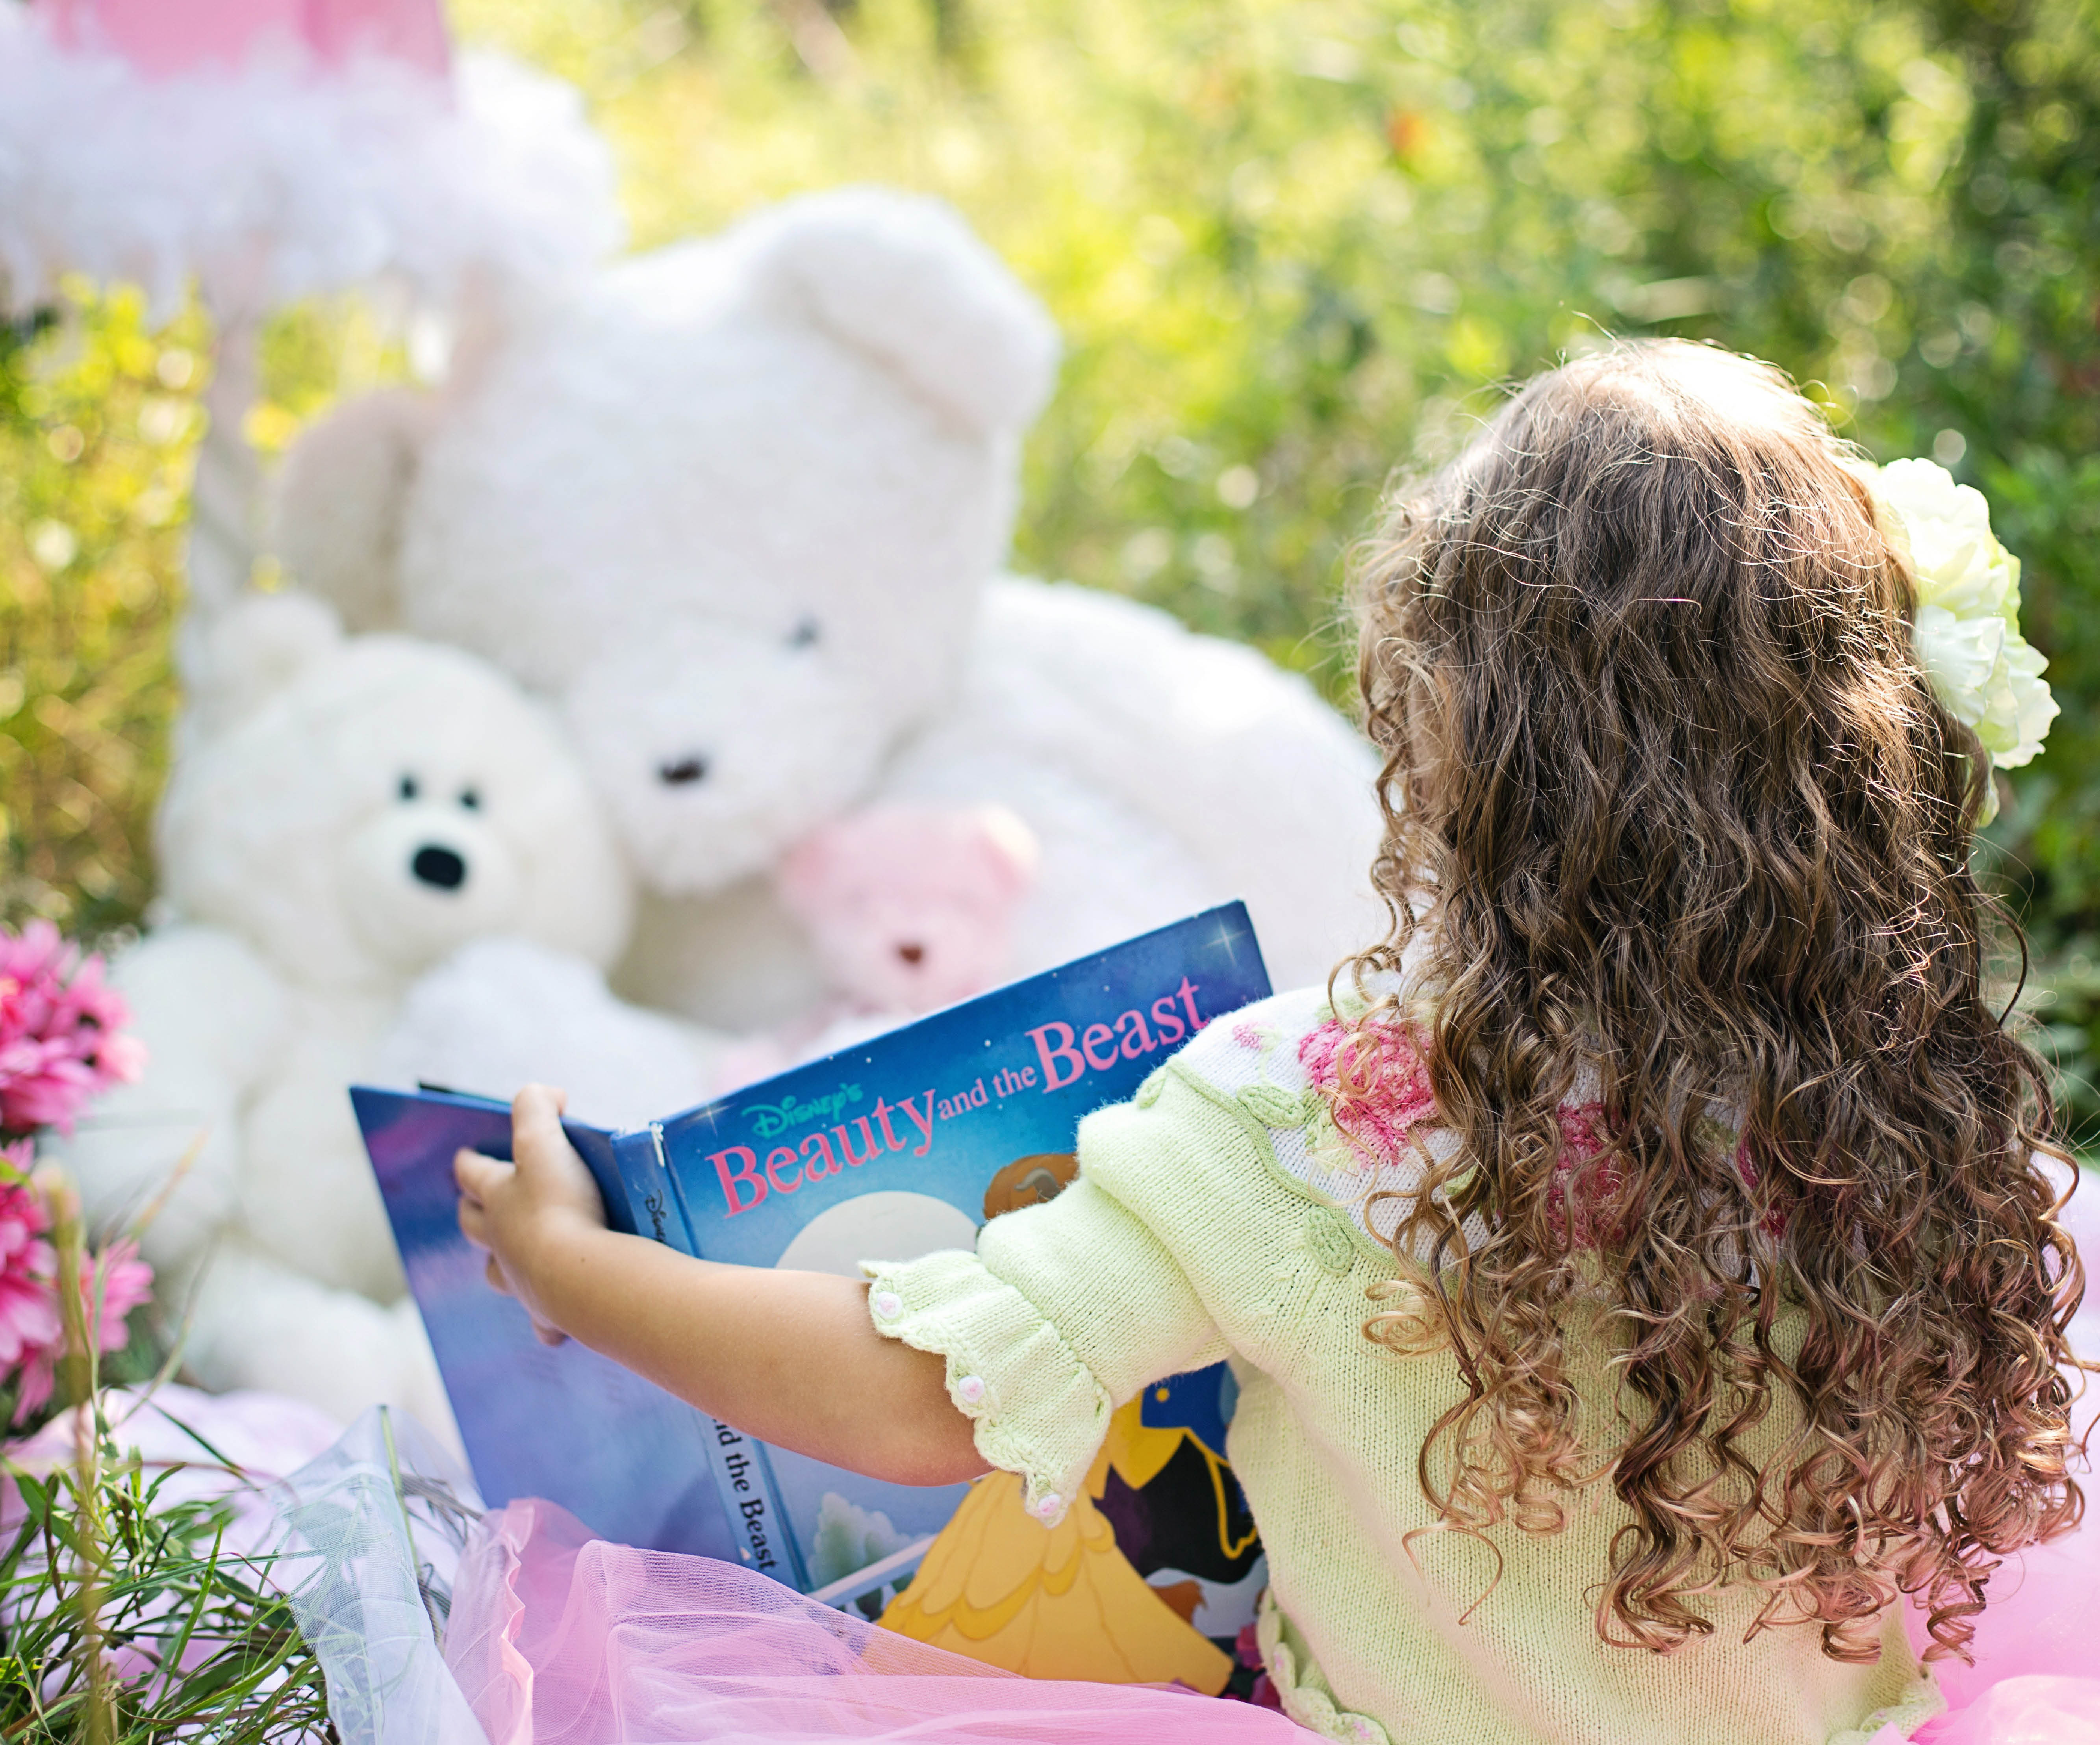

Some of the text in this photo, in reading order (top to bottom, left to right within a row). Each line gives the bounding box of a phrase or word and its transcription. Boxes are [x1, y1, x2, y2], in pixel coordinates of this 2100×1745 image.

[704, 976, 1210, 1218] Beauty and the Beast
[741, 1083, 864, 1139] Disney's
[725, 1453, 750, 1493] the
[739, 1498, 777, 1570] Beast
